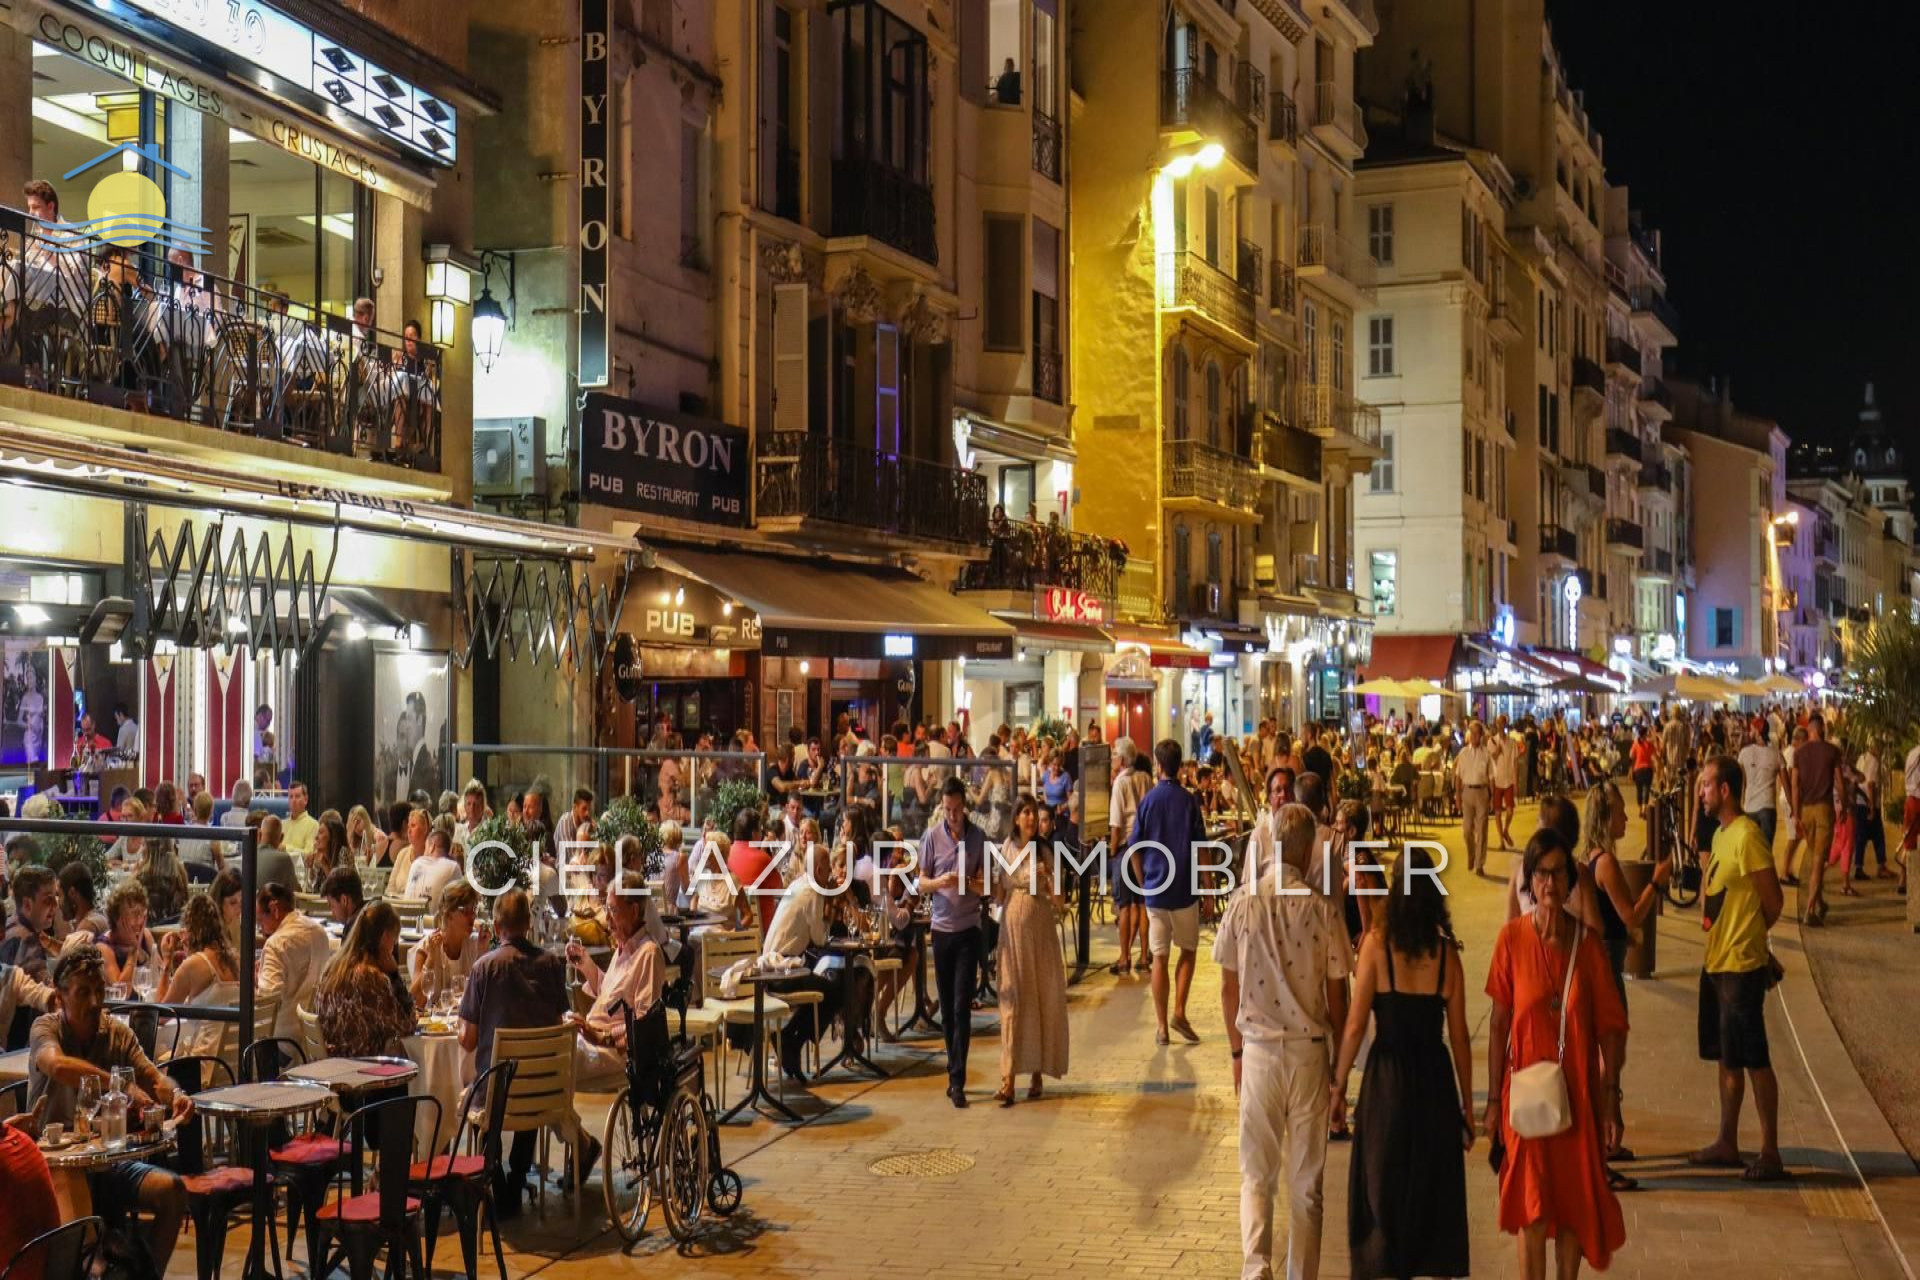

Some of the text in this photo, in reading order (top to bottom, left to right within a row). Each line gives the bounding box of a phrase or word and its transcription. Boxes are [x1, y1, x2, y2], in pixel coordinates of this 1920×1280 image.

[39, 13, 222, 115] COQUILLAGES
[580, 32, 607, 314] BYRON
[601, 409, 733, 474] BYRON
[589, 472, 740, 513] PUB RESTAURANT PUB
[646, 609, 695, 637] PUB
